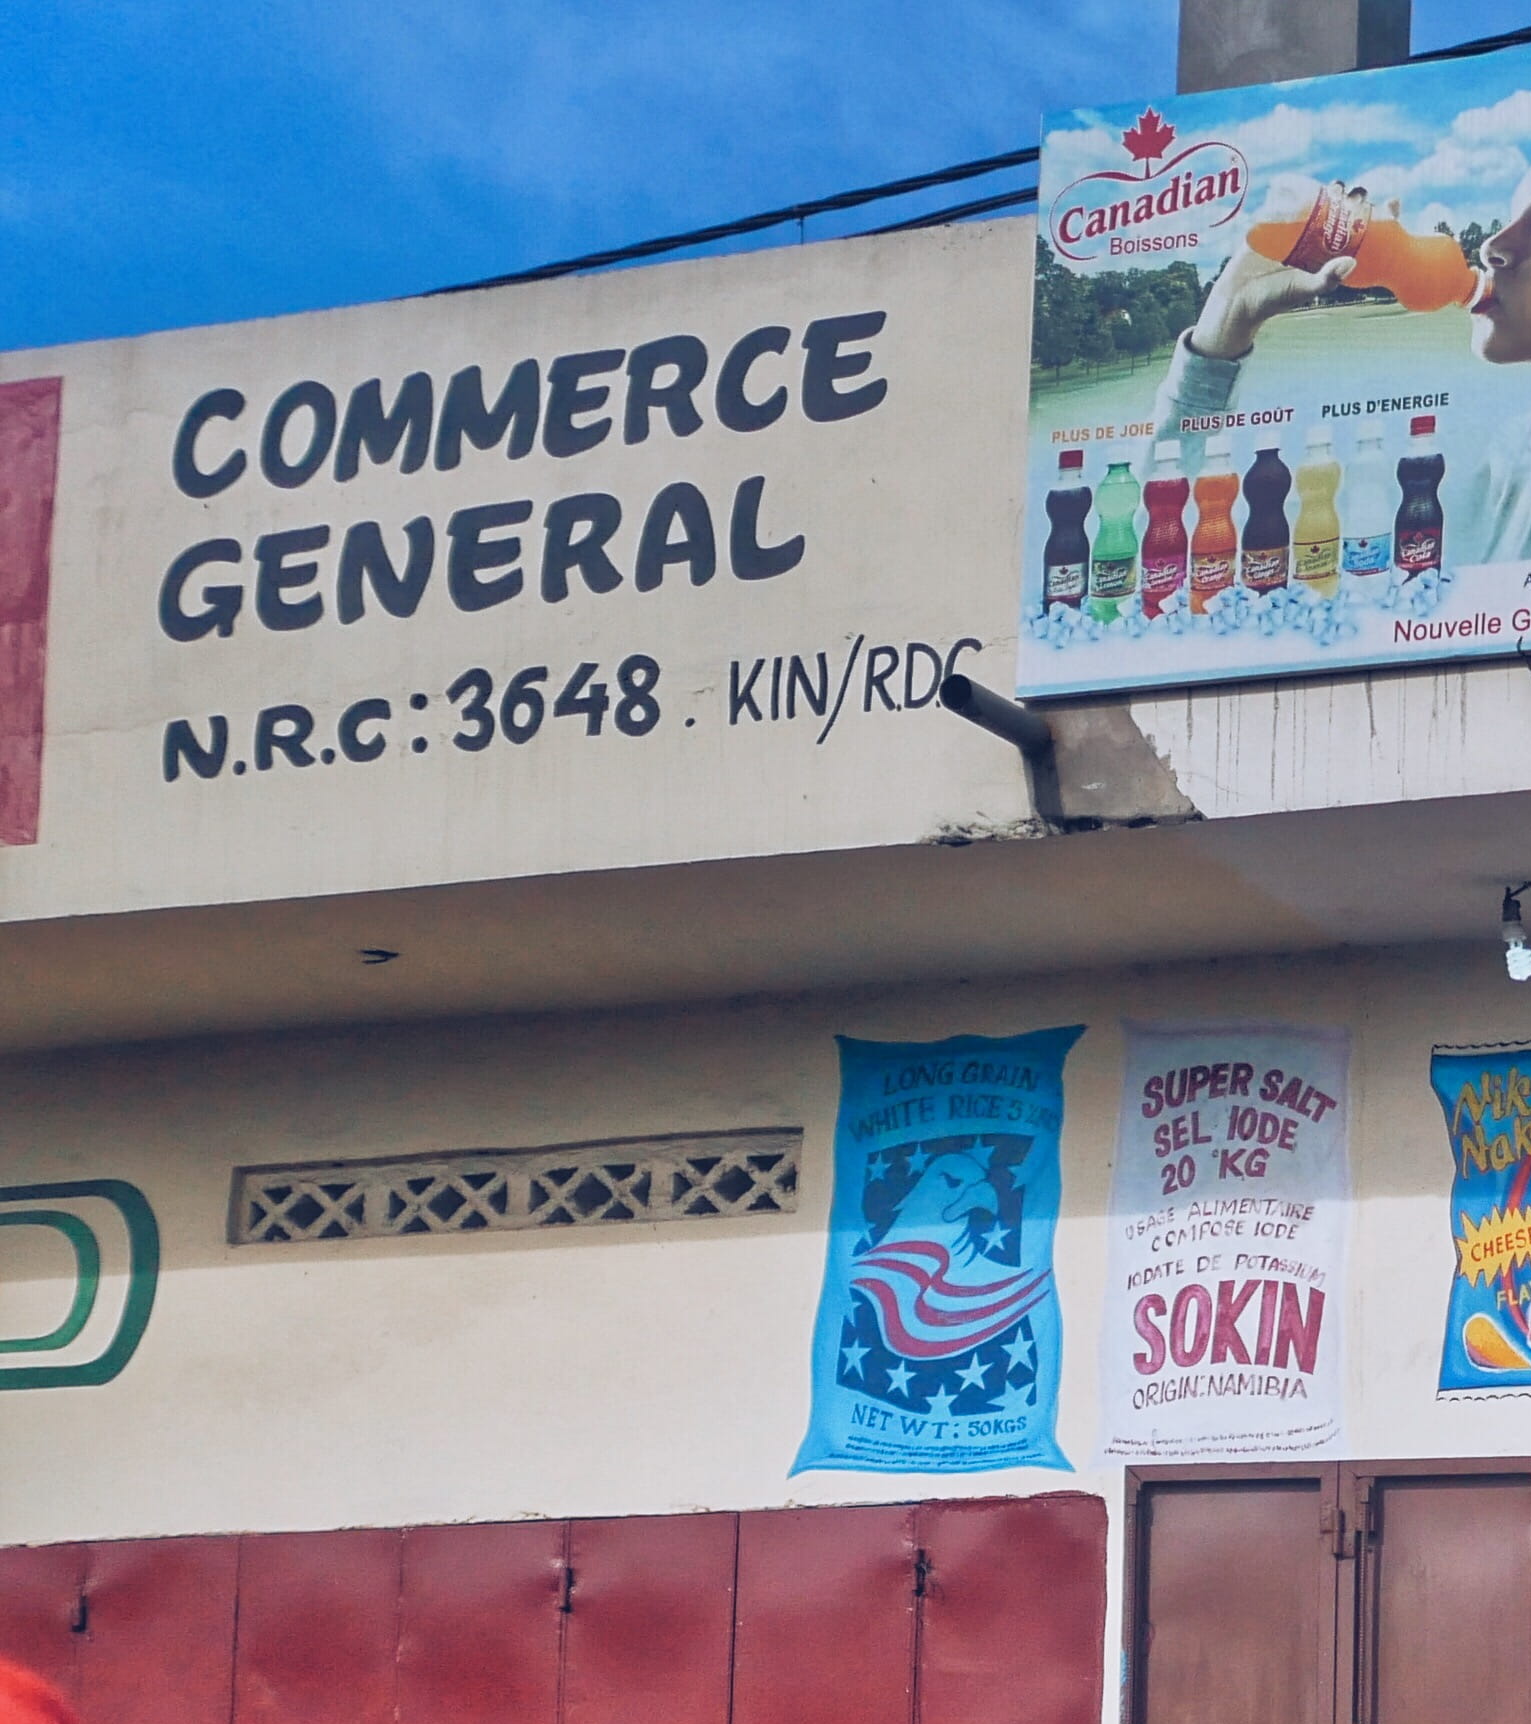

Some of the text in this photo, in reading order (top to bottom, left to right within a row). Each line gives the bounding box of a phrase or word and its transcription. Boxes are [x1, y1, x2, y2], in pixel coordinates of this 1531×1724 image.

[1059, 165, 1240, 244] Canadian
[1109, 233, 1198, 256] Boissons
[172, 310, 888, 499] COMMERCE
[1181, 406, 1294, 432] PLUS DE GOÛT
[1321, 392, 1450, 418] PLUS D'ENERGIE
[1051, 421, 1154, 443] PLUS DE JOIE
[158, 476, 805, 643] GENERAL
[1393, 612, 1503, 643] Nouvelle
[884, 1061, 1037, 1096] LONG GRAIN
[1142, 1062, 1337, 1124] SUPER SALT
[851, 1096, 935, 1142] WHITE
[949, 1094, 1003, 1120] RICE
[1154, 1105, 1298, 1158] SEL IODE
[1161, 1149, 1270, 1196] 20 KG
[1125, 1198, 1315, 1241] USAGE ALIMENTAIRE
[1151, 1220, 1299, 1252] COMPOSE IODE
[1127, 1254, 1326, 1291] IODATE DE POTASSIUM
[1132, 1279, 1326, 1376] SOKIN
[851, 1404, 893, 1430] NET
[967, 1415, 1027, 1438] 50KGS
